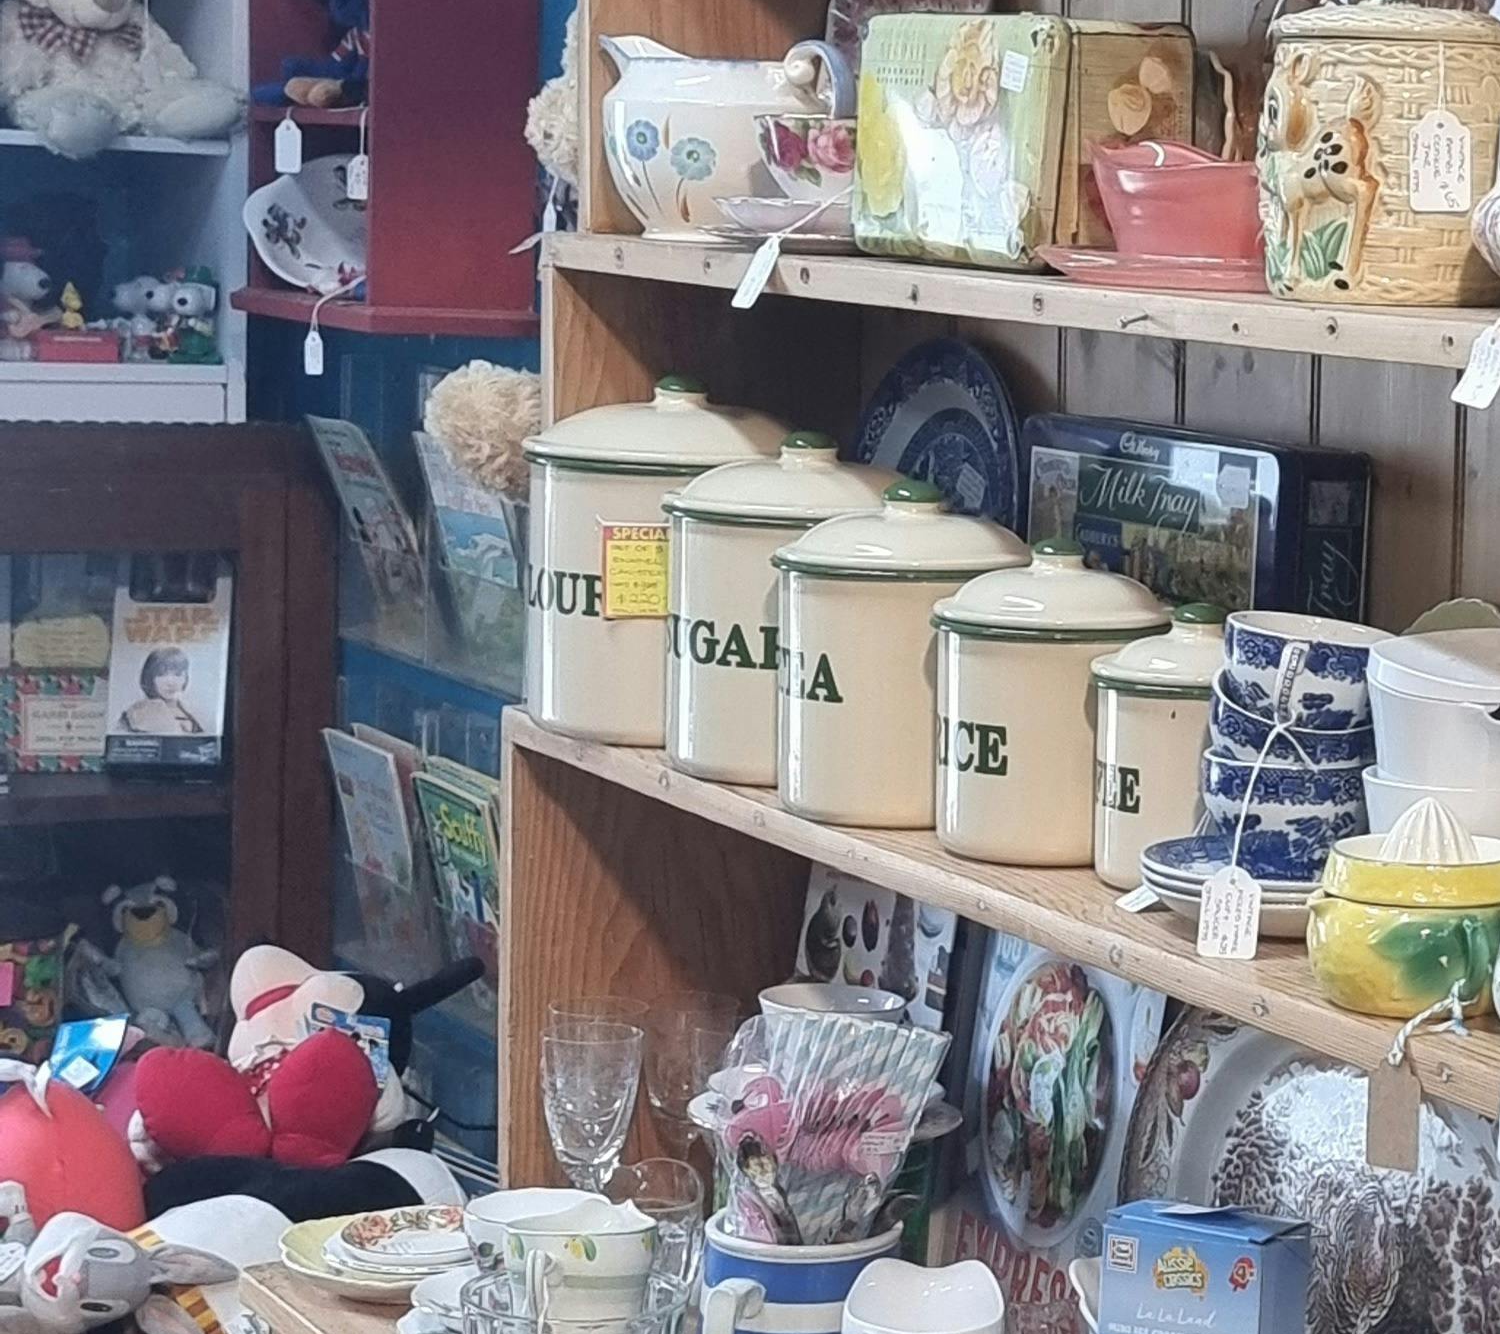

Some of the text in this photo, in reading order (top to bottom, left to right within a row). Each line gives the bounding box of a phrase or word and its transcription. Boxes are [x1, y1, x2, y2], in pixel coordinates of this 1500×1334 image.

[1079, 463, 1146, 511] Milk
[1144, 474, 1199, 536] Tray
[779, 650, 844, 704] EA
